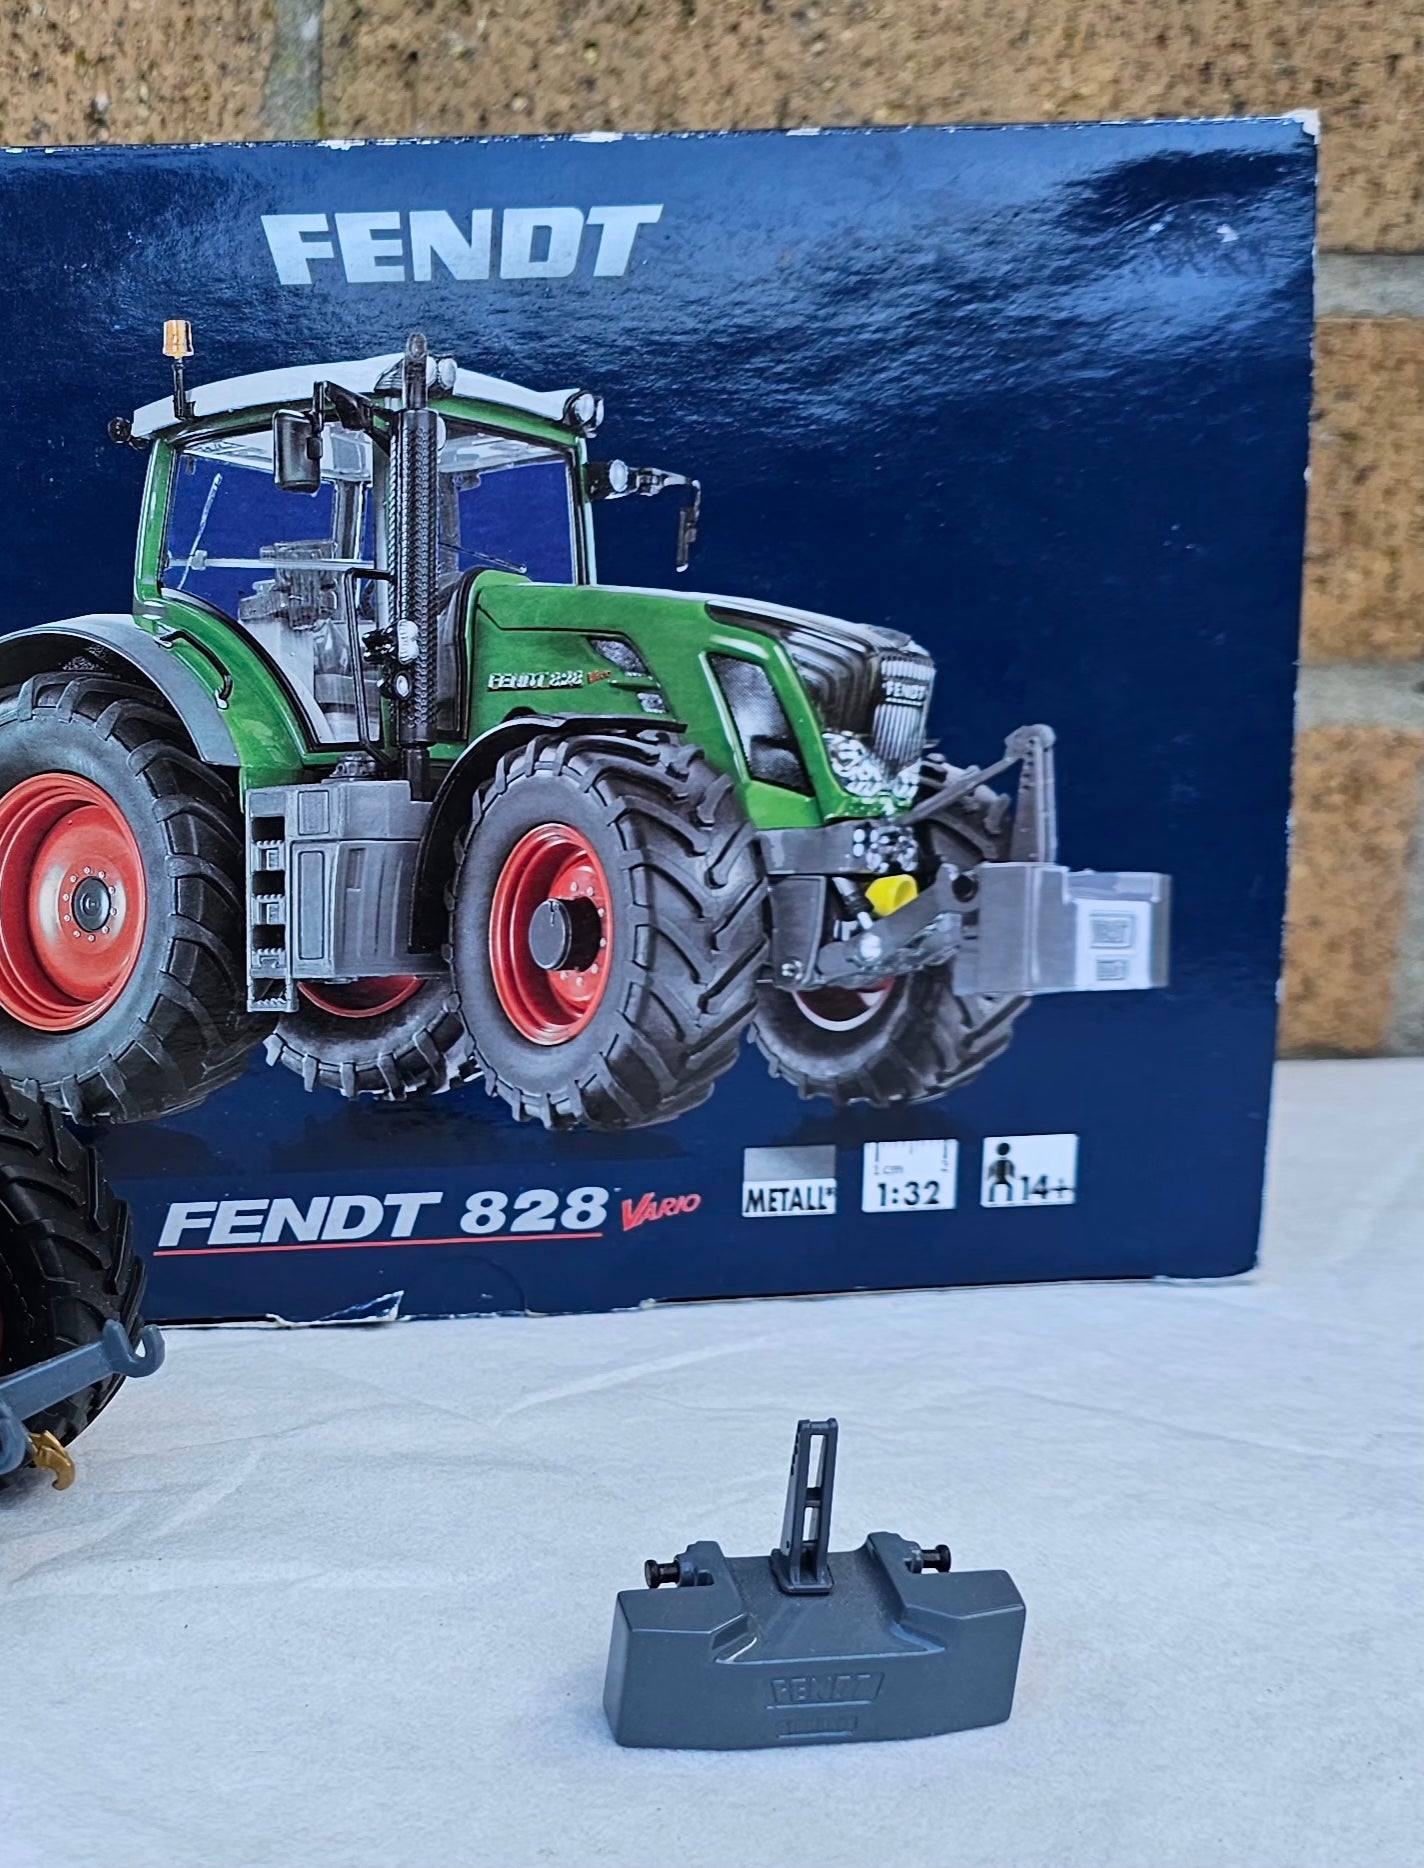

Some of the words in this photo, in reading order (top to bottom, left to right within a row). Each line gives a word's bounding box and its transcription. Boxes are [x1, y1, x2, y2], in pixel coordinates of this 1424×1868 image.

[260, 203, 664, 286] FENDT
[487, 672, 549, 689] FENDT
[877, 1180, 941, 1207] 1:32
[1020, 1174, 1076, 1201] 14+
[158, 1191, 444, 1248] FENDT
[460, 1186, 610, 1235] 828
